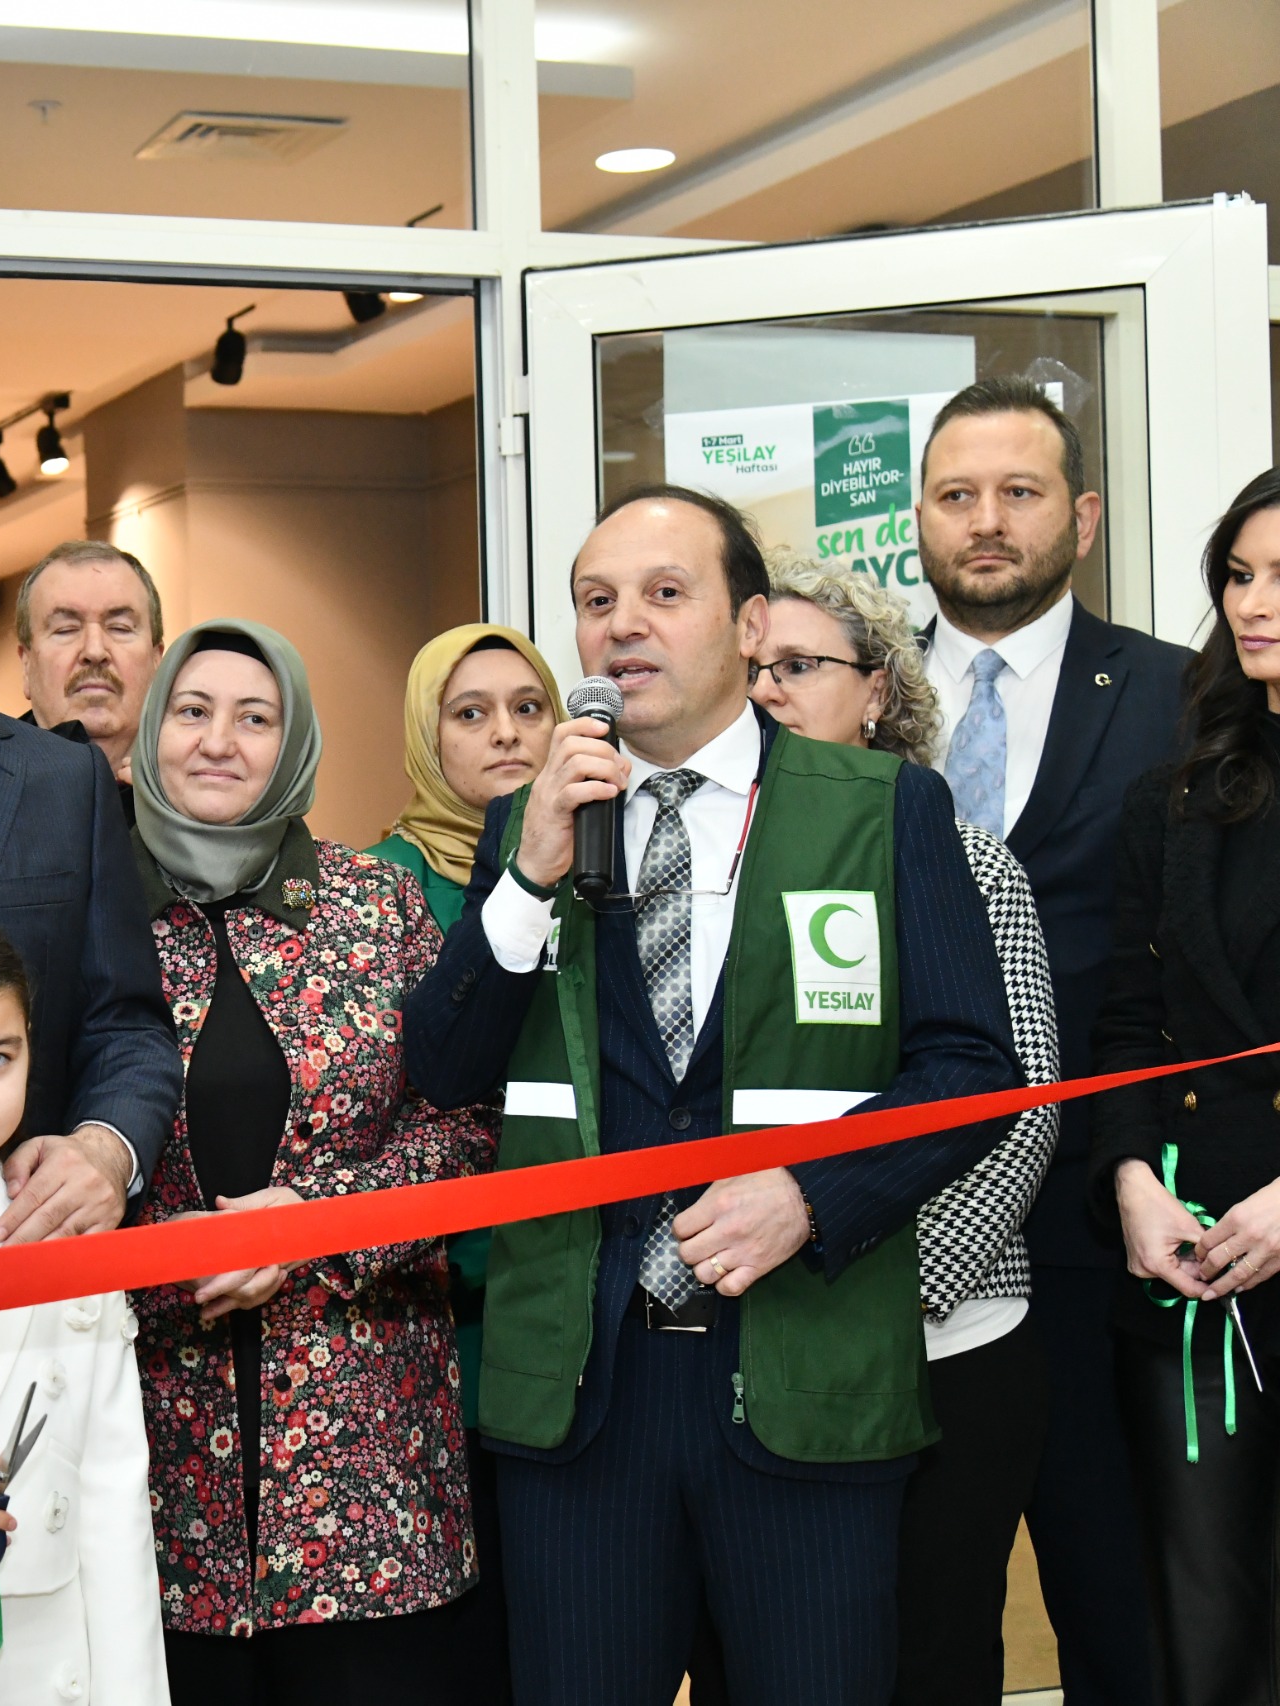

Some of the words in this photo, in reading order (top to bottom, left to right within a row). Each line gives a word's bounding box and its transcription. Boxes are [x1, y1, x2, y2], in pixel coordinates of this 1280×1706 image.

[719, 435, 742, 446] Mart
[736, 463, 778, 473] Haftası
[843, 457, 882, 476] HAYIR
[821, 469, 905, 496] DİYEBİLİYOR-
[850, 489, 876, 507] SAN
[817, 527, 865, 559] sen
[876, 502, 913, 547] de
